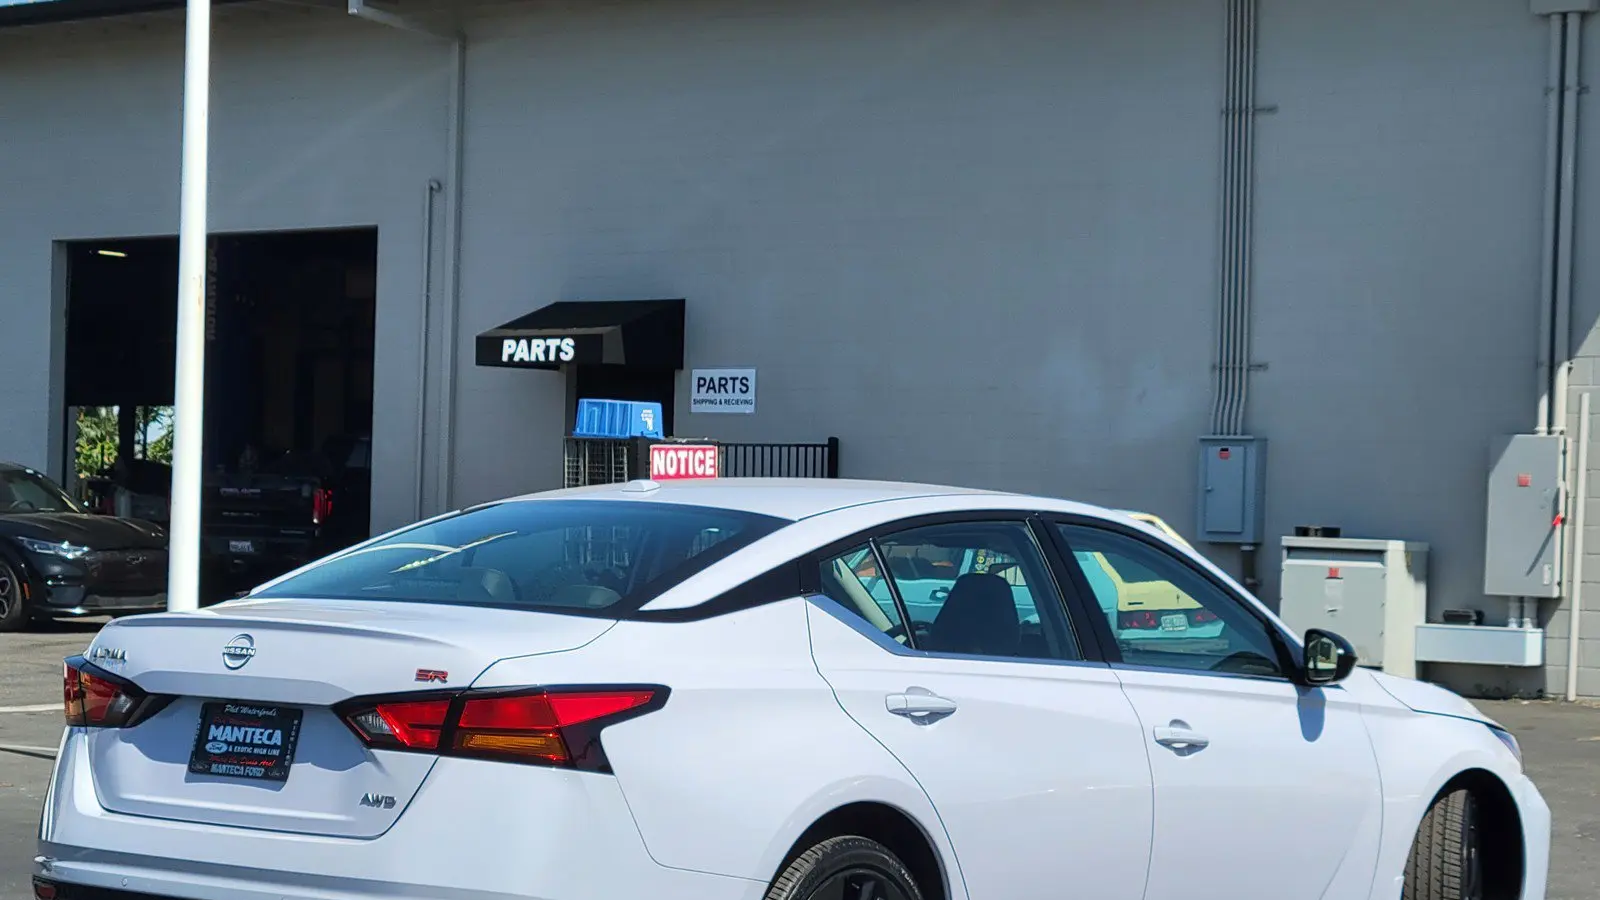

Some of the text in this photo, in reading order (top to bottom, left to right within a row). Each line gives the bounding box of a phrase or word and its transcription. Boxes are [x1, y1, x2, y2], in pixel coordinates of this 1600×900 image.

[501, 338, 576, 363] PARTS
[696, 376, 750, 395] PARTS
[692, 398, 717, 406] SHIPPING
[652, 450, 716, 476] NOTICE
[222, 646, 256, 656] NISSAN
[415, 668, 449, 684] SR
[208, 724, 282, 746] MANTECA
[233, 746, 253, 754] EXOTIC
[253, 747, 267, 755] HIGH
[268, 748, 281, 756] LINE
[210, 763, 265, 777] MANTECA FORD
[359, 793, 397, 809] AWD
